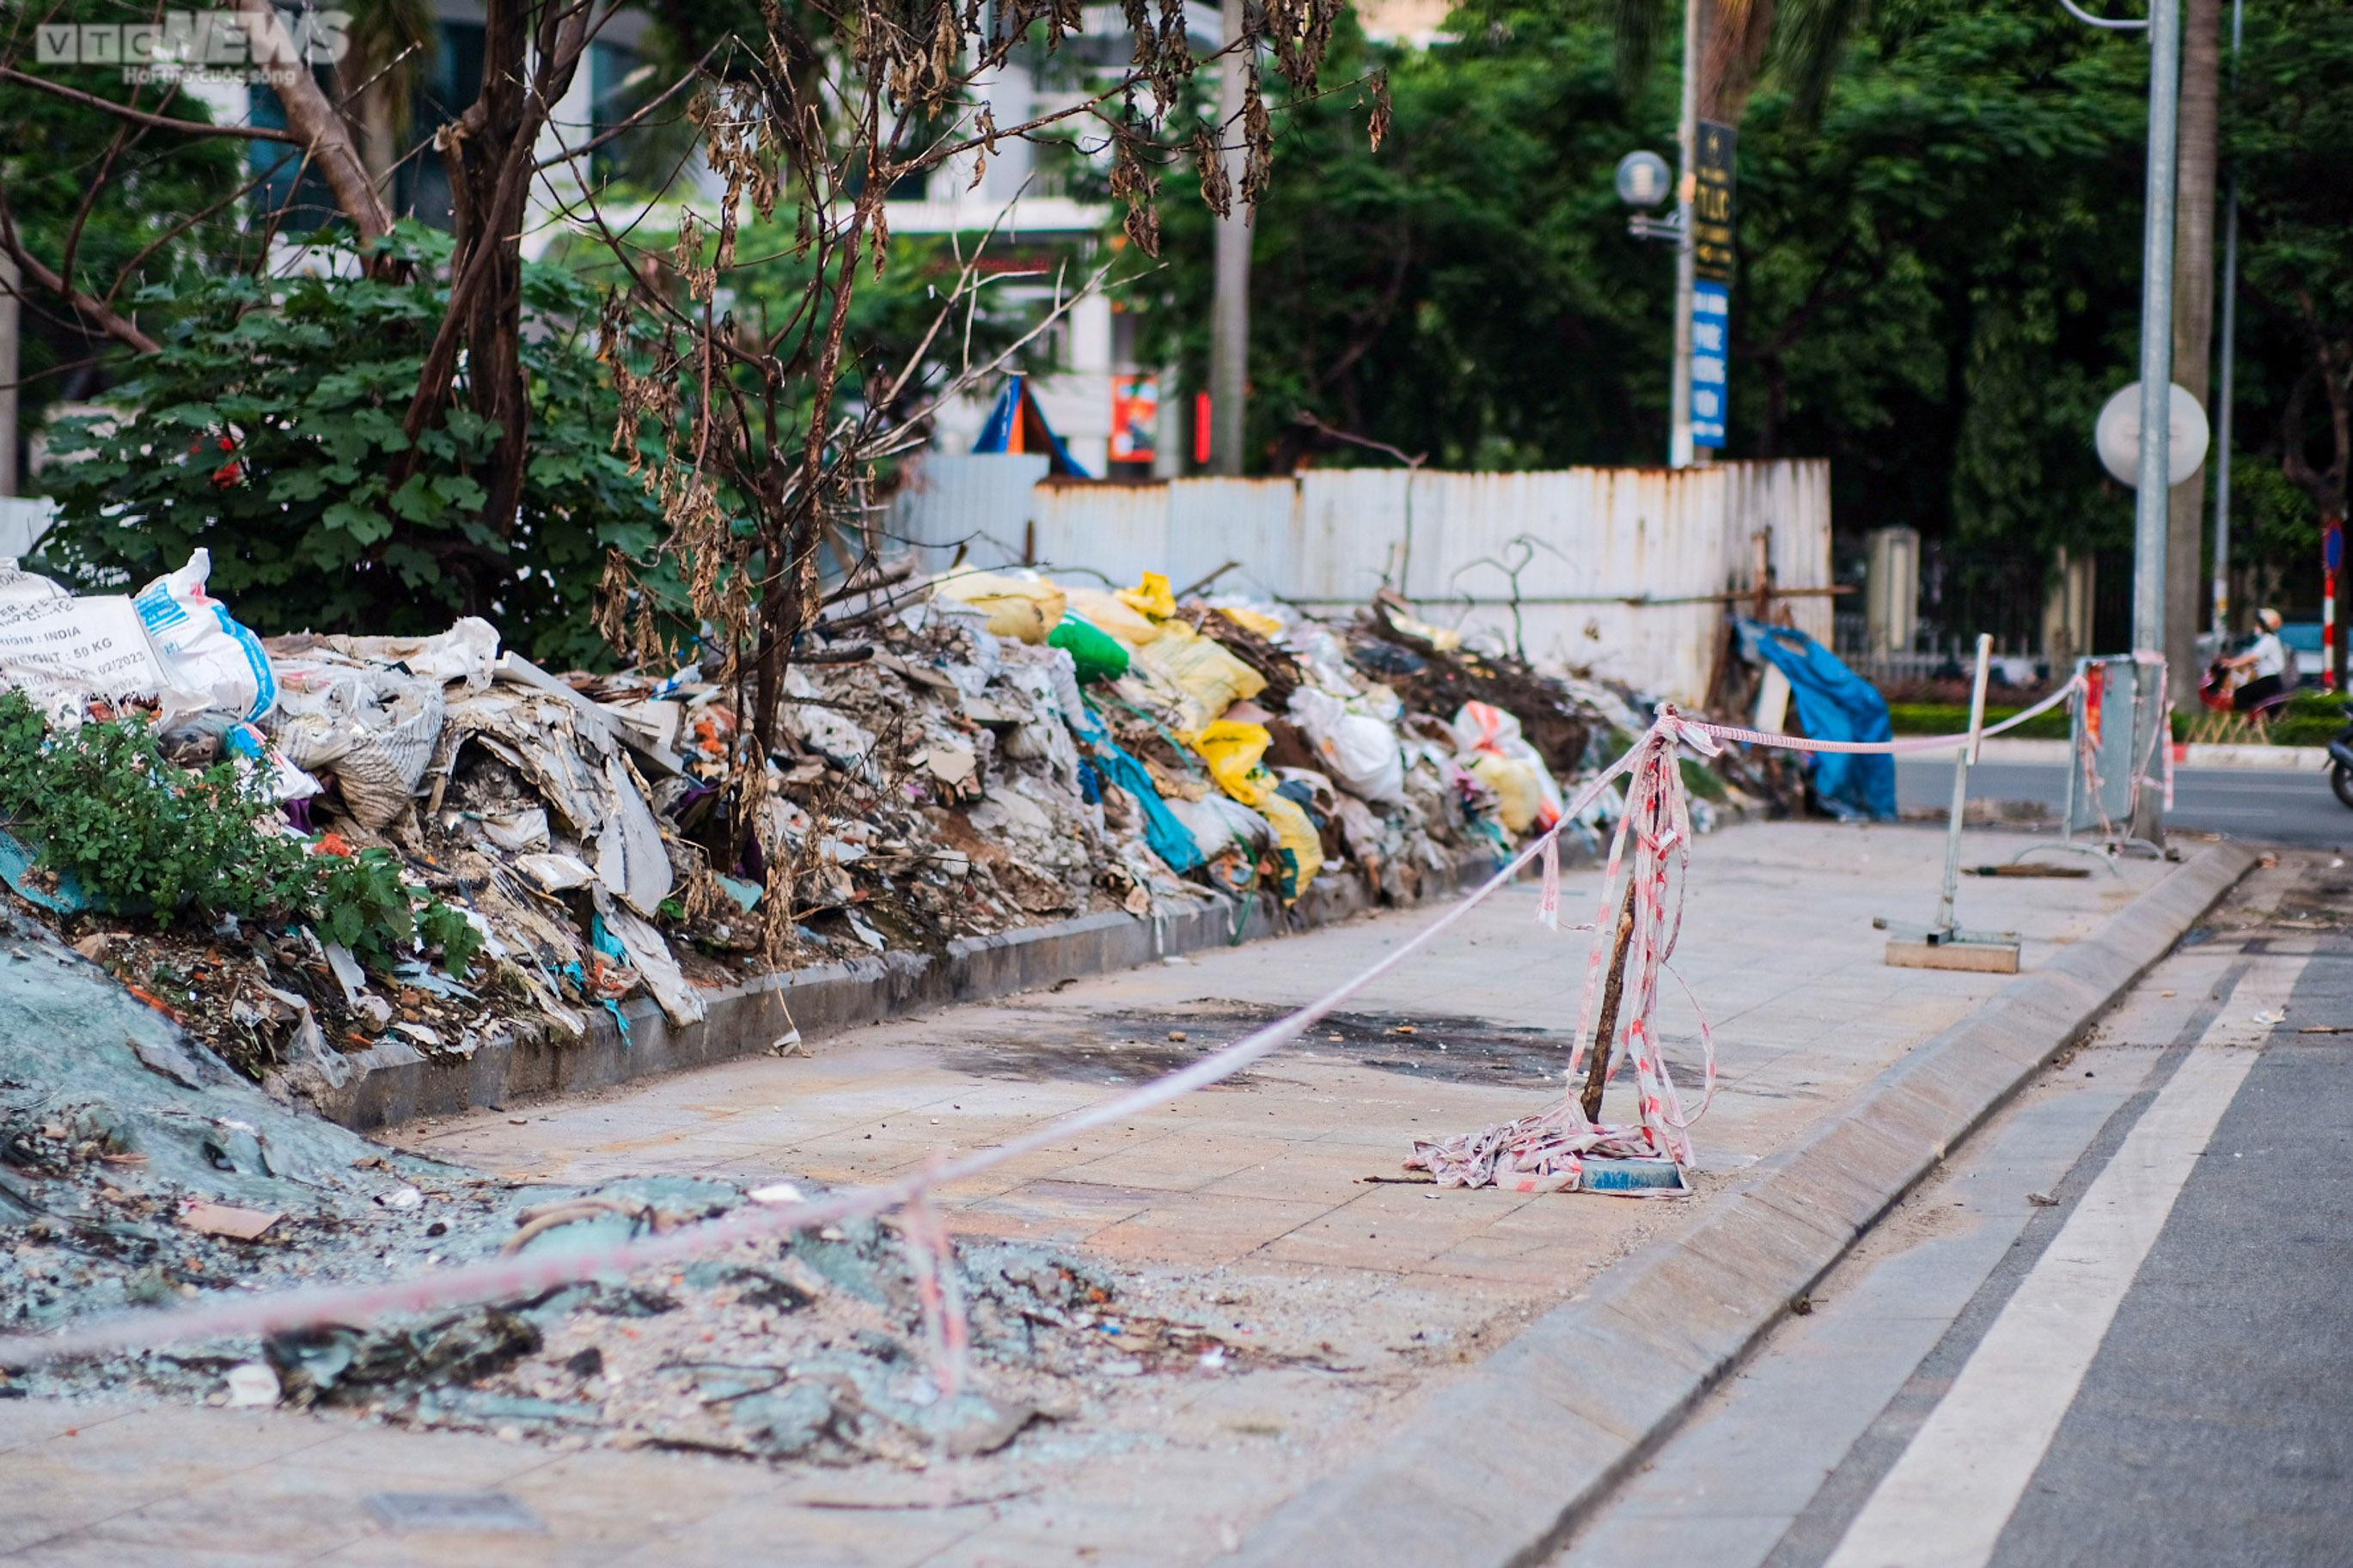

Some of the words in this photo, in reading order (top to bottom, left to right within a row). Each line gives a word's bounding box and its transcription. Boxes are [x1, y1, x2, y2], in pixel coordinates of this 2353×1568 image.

[44, 625, 81, 642] INDIA
[74, 646, 89, 659] 50
[92, 638, 112, 653] KG
